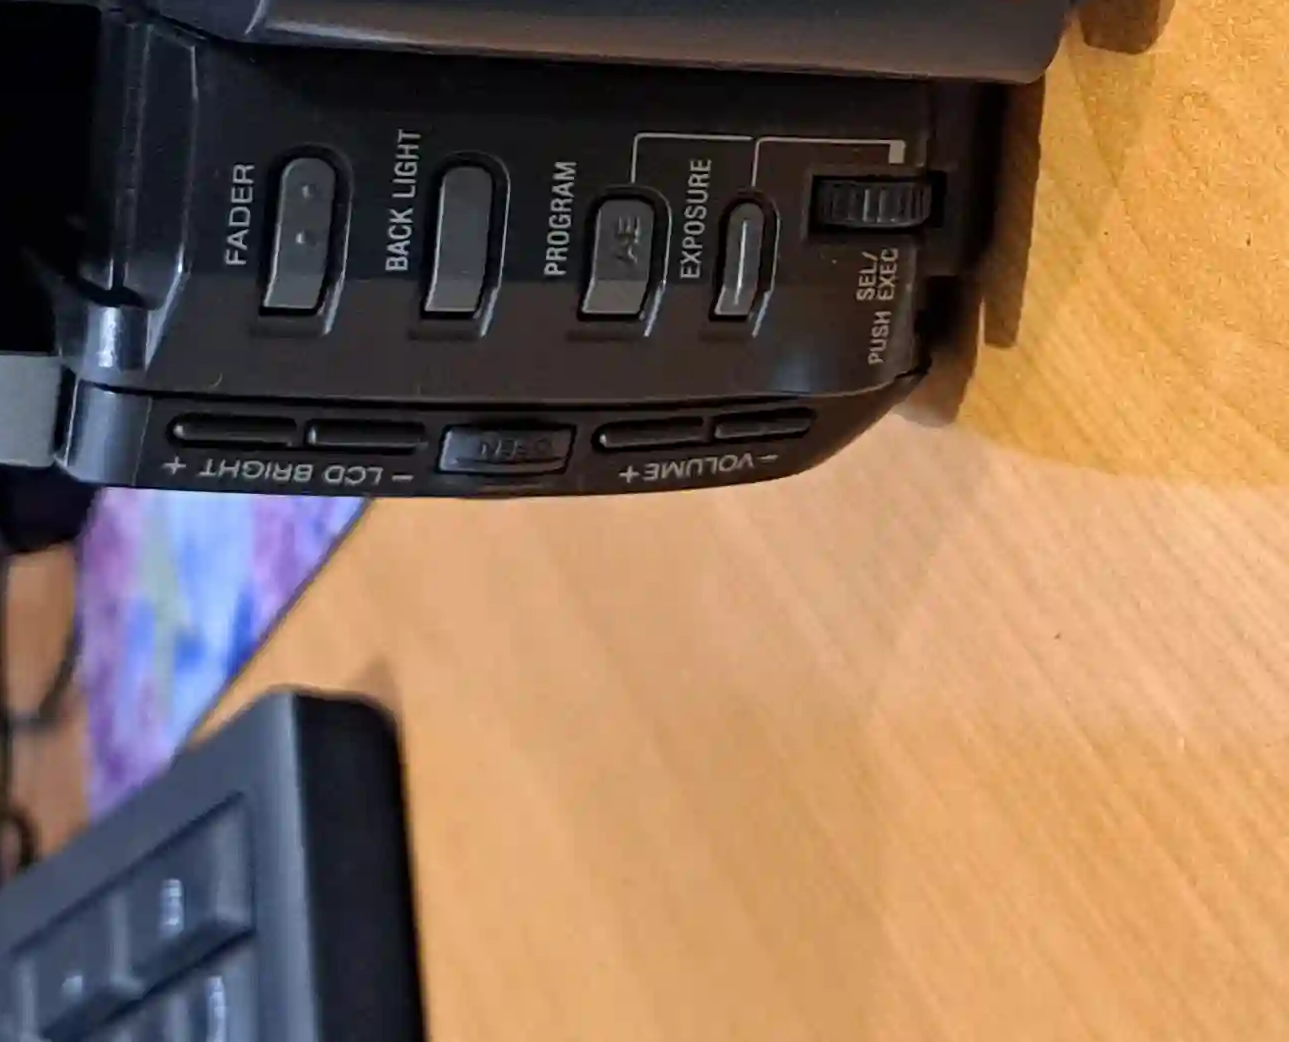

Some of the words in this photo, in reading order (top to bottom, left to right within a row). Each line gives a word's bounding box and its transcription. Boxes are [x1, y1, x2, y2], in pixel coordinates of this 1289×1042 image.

[391, 128, 421, 199] LIGHT
[224, 163, 255, 266] FADER
[384, 207, 414, 272] BACK
[543, 160, 577, 277] PROGRAM
[679, 158, 713, 279] EXPOSURE
[855, 251, 879, 301] SEL/
[876, 247, 900, 301] EXEC
[867, 310, 893, 365] PUSH
[198, 457, 313, 484] BRIGHT
[322, 464, 385, 486] LCD
